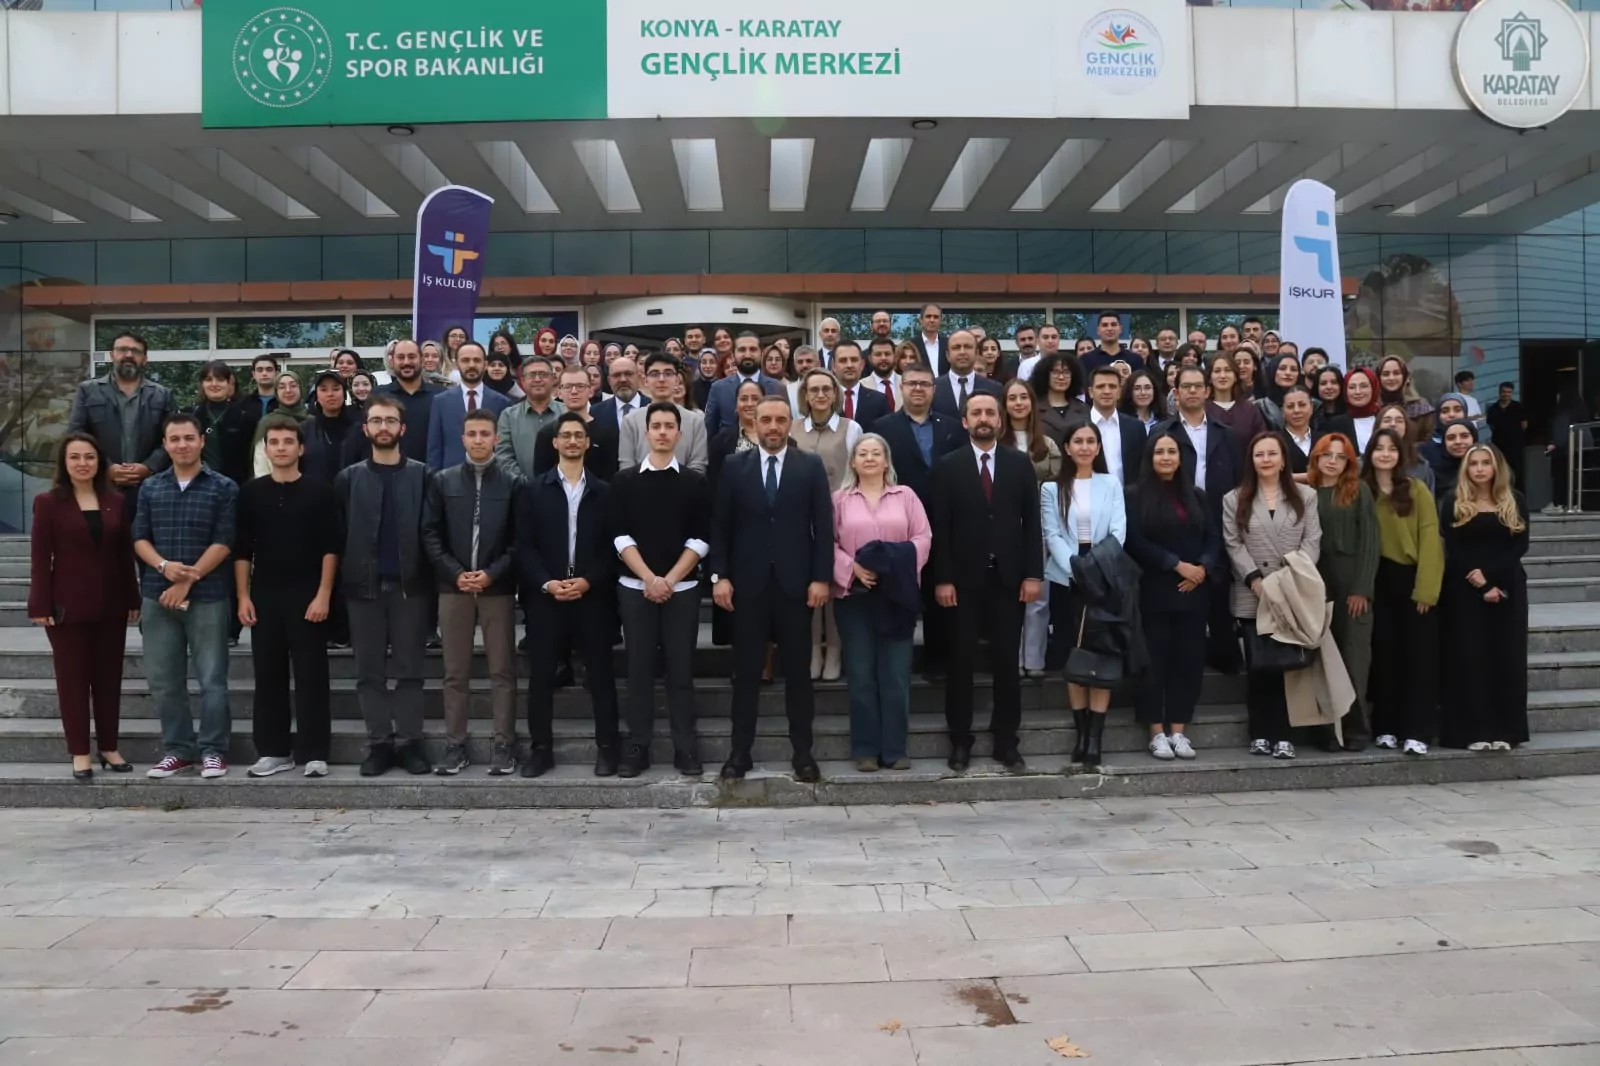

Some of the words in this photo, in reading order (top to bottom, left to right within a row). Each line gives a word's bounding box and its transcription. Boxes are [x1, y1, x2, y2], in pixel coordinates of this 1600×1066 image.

[346, 32, 388, 50] T.C.
[396, 26, 504, 53] GENÇLİK
[512, 29, 544, 47] VE
[640, 19, 719, 38] KONYA
[739, 19, 842, 38] KARATAY
[346, 58, 408, 78] SPOR
[415, 52, 544, 76] BAKANLIĞI
[640, 47, 767, 82] GENÇLİK
[774, 47, 901, 75] MERKEZİ
[1086, 51, 1154, 65] GENÇLİK
[1483, 74, 1560, 95] KARATAY
